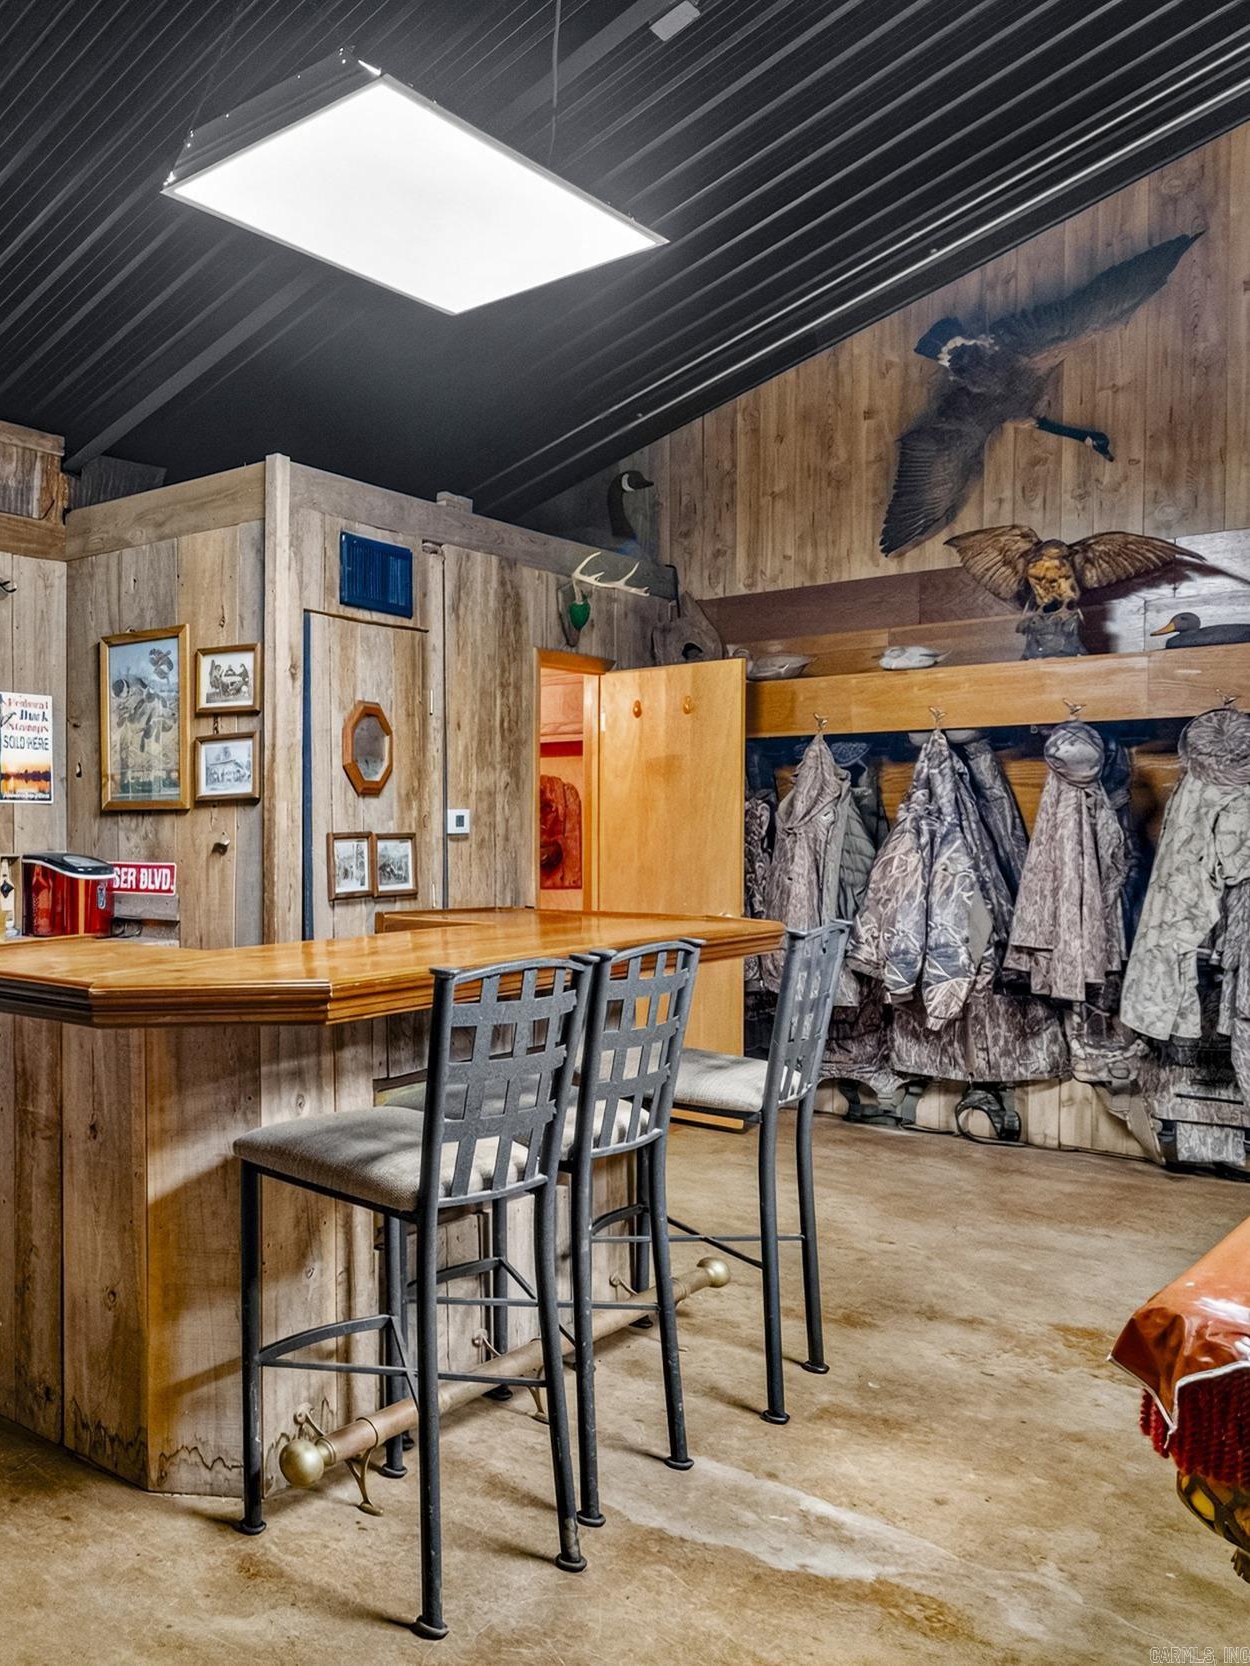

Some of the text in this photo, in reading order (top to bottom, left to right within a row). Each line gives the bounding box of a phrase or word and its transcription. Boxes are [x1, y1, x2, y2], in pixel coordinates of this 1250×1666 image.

[2, 735, 50, 751] SOLD HERE
[139, 868, 175, 891] BLVD.
